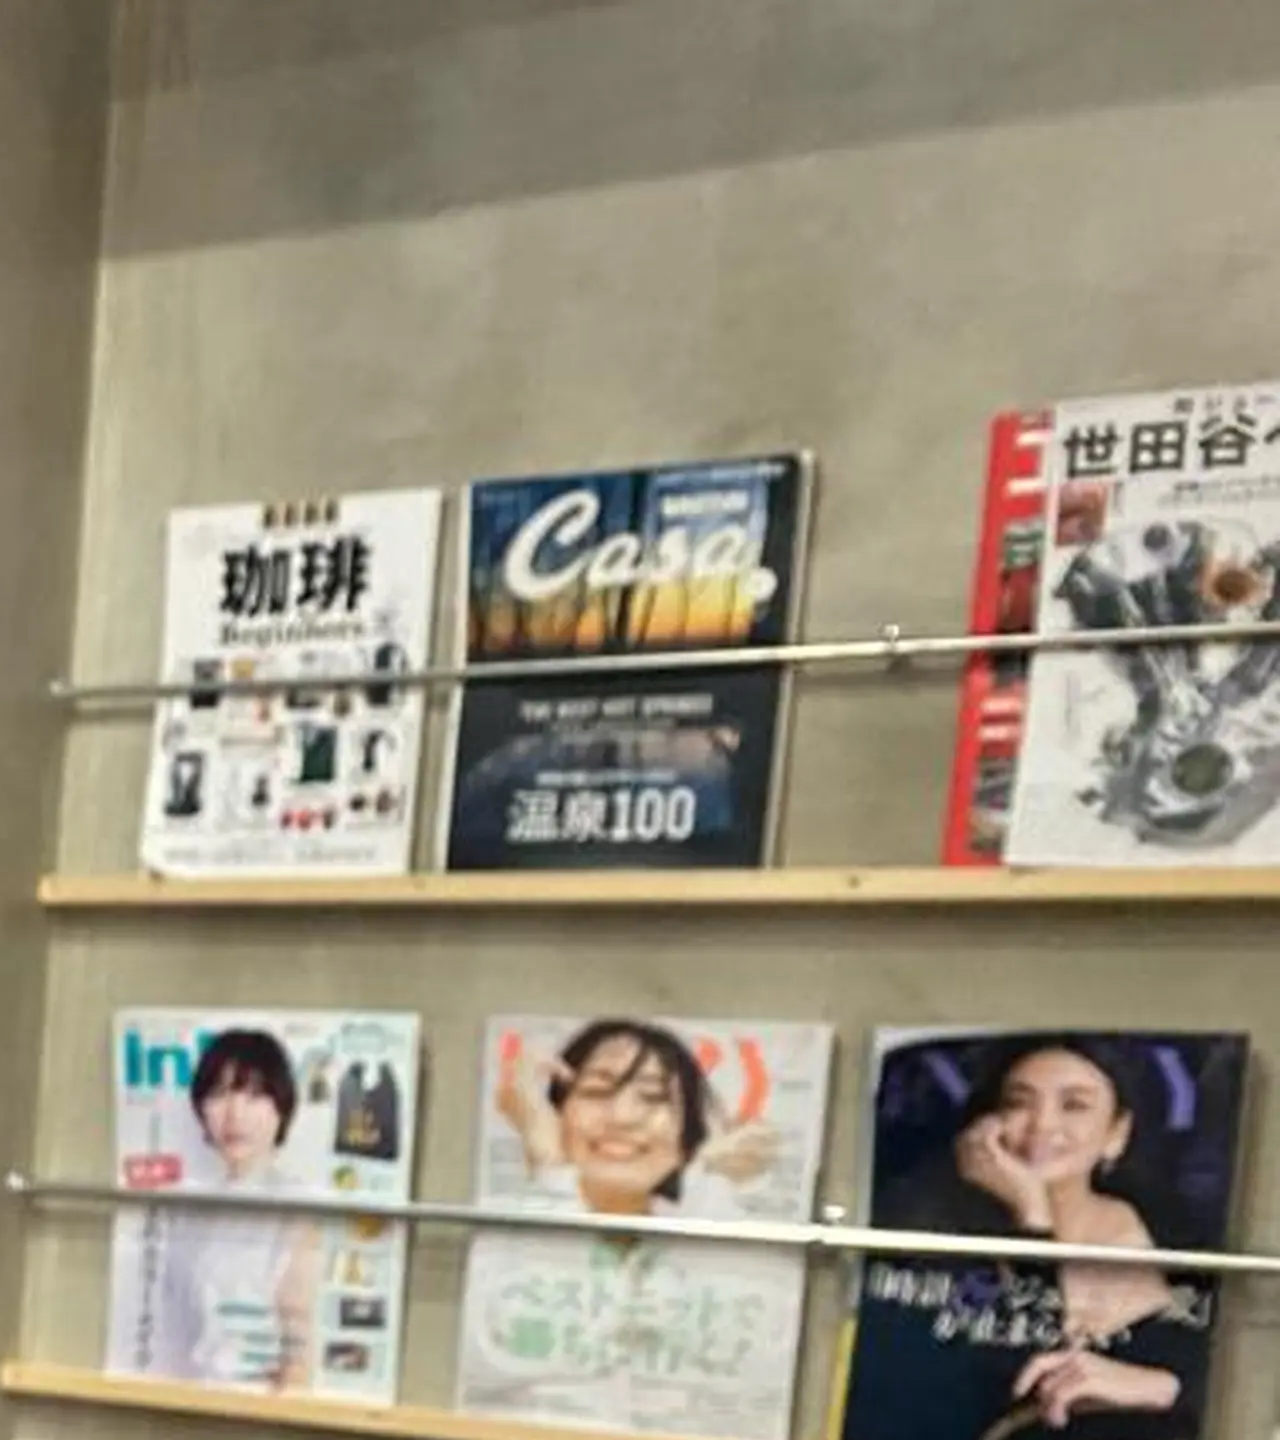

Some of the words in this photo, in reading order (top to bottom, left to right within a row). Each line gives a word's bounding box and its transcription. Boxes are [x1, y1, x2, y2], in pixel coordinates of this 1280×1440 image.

[219, 533, 370, 620] 珈琲
[504, 489, 762, 600] Casa
[506, 784, 696, 843] 温泉100
